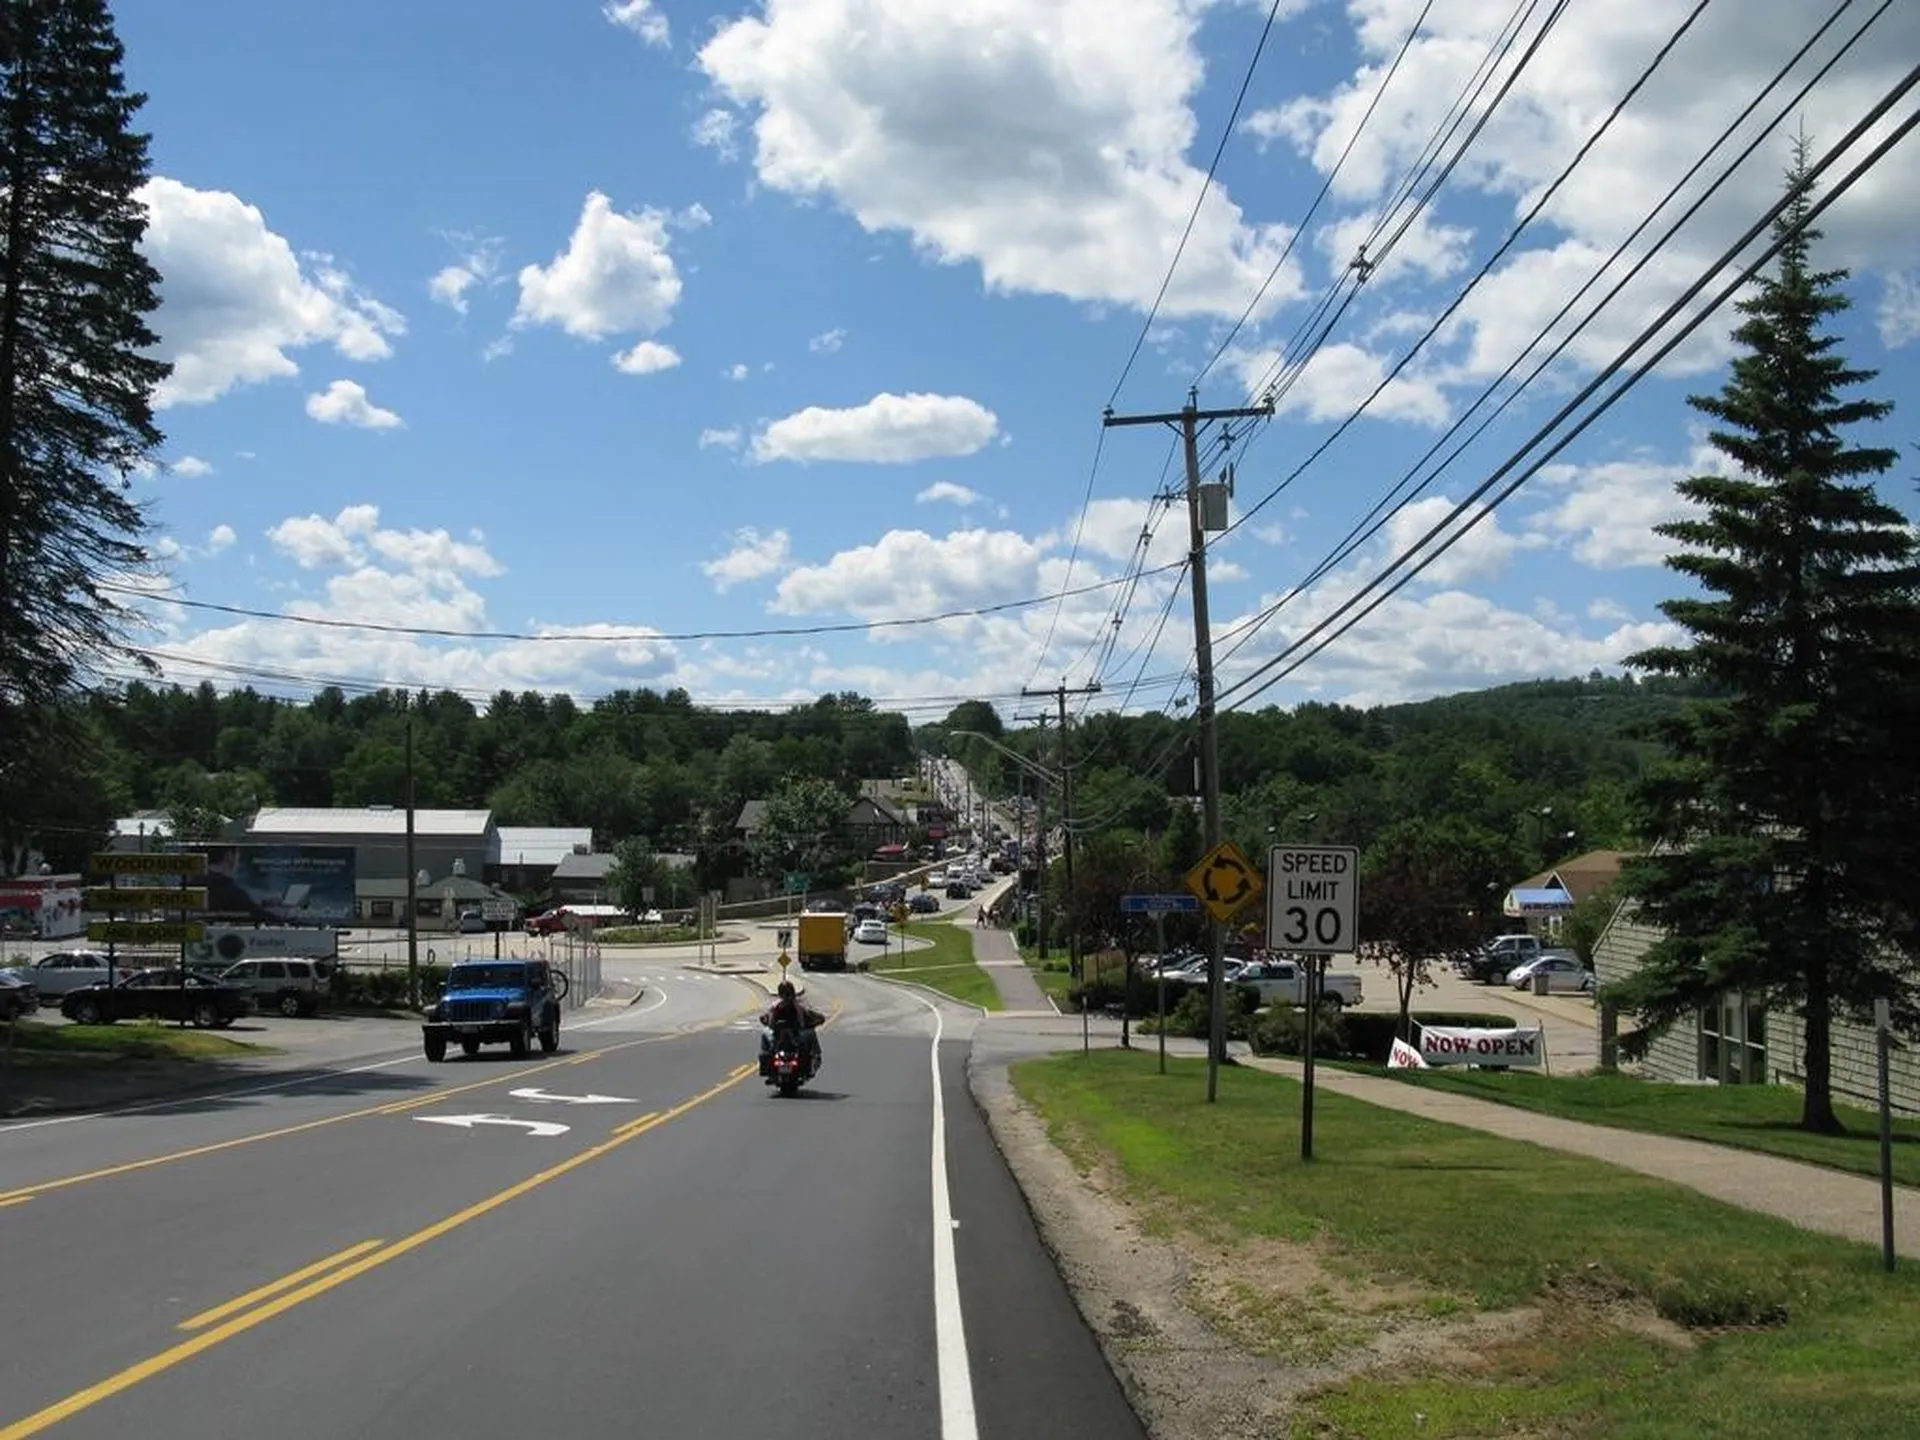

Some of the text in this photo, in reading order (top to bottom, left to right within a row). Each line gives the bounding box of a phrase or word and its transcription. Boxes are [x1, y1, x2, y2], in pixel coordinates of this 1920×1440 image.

[1282, 852, 1347, 873] SPEED
[1287, 879, 1340, 901] LIMIT
[1283, 905, 1342, 946] 30
[1425, 1035, 1536, 1056] NOW OPEN
